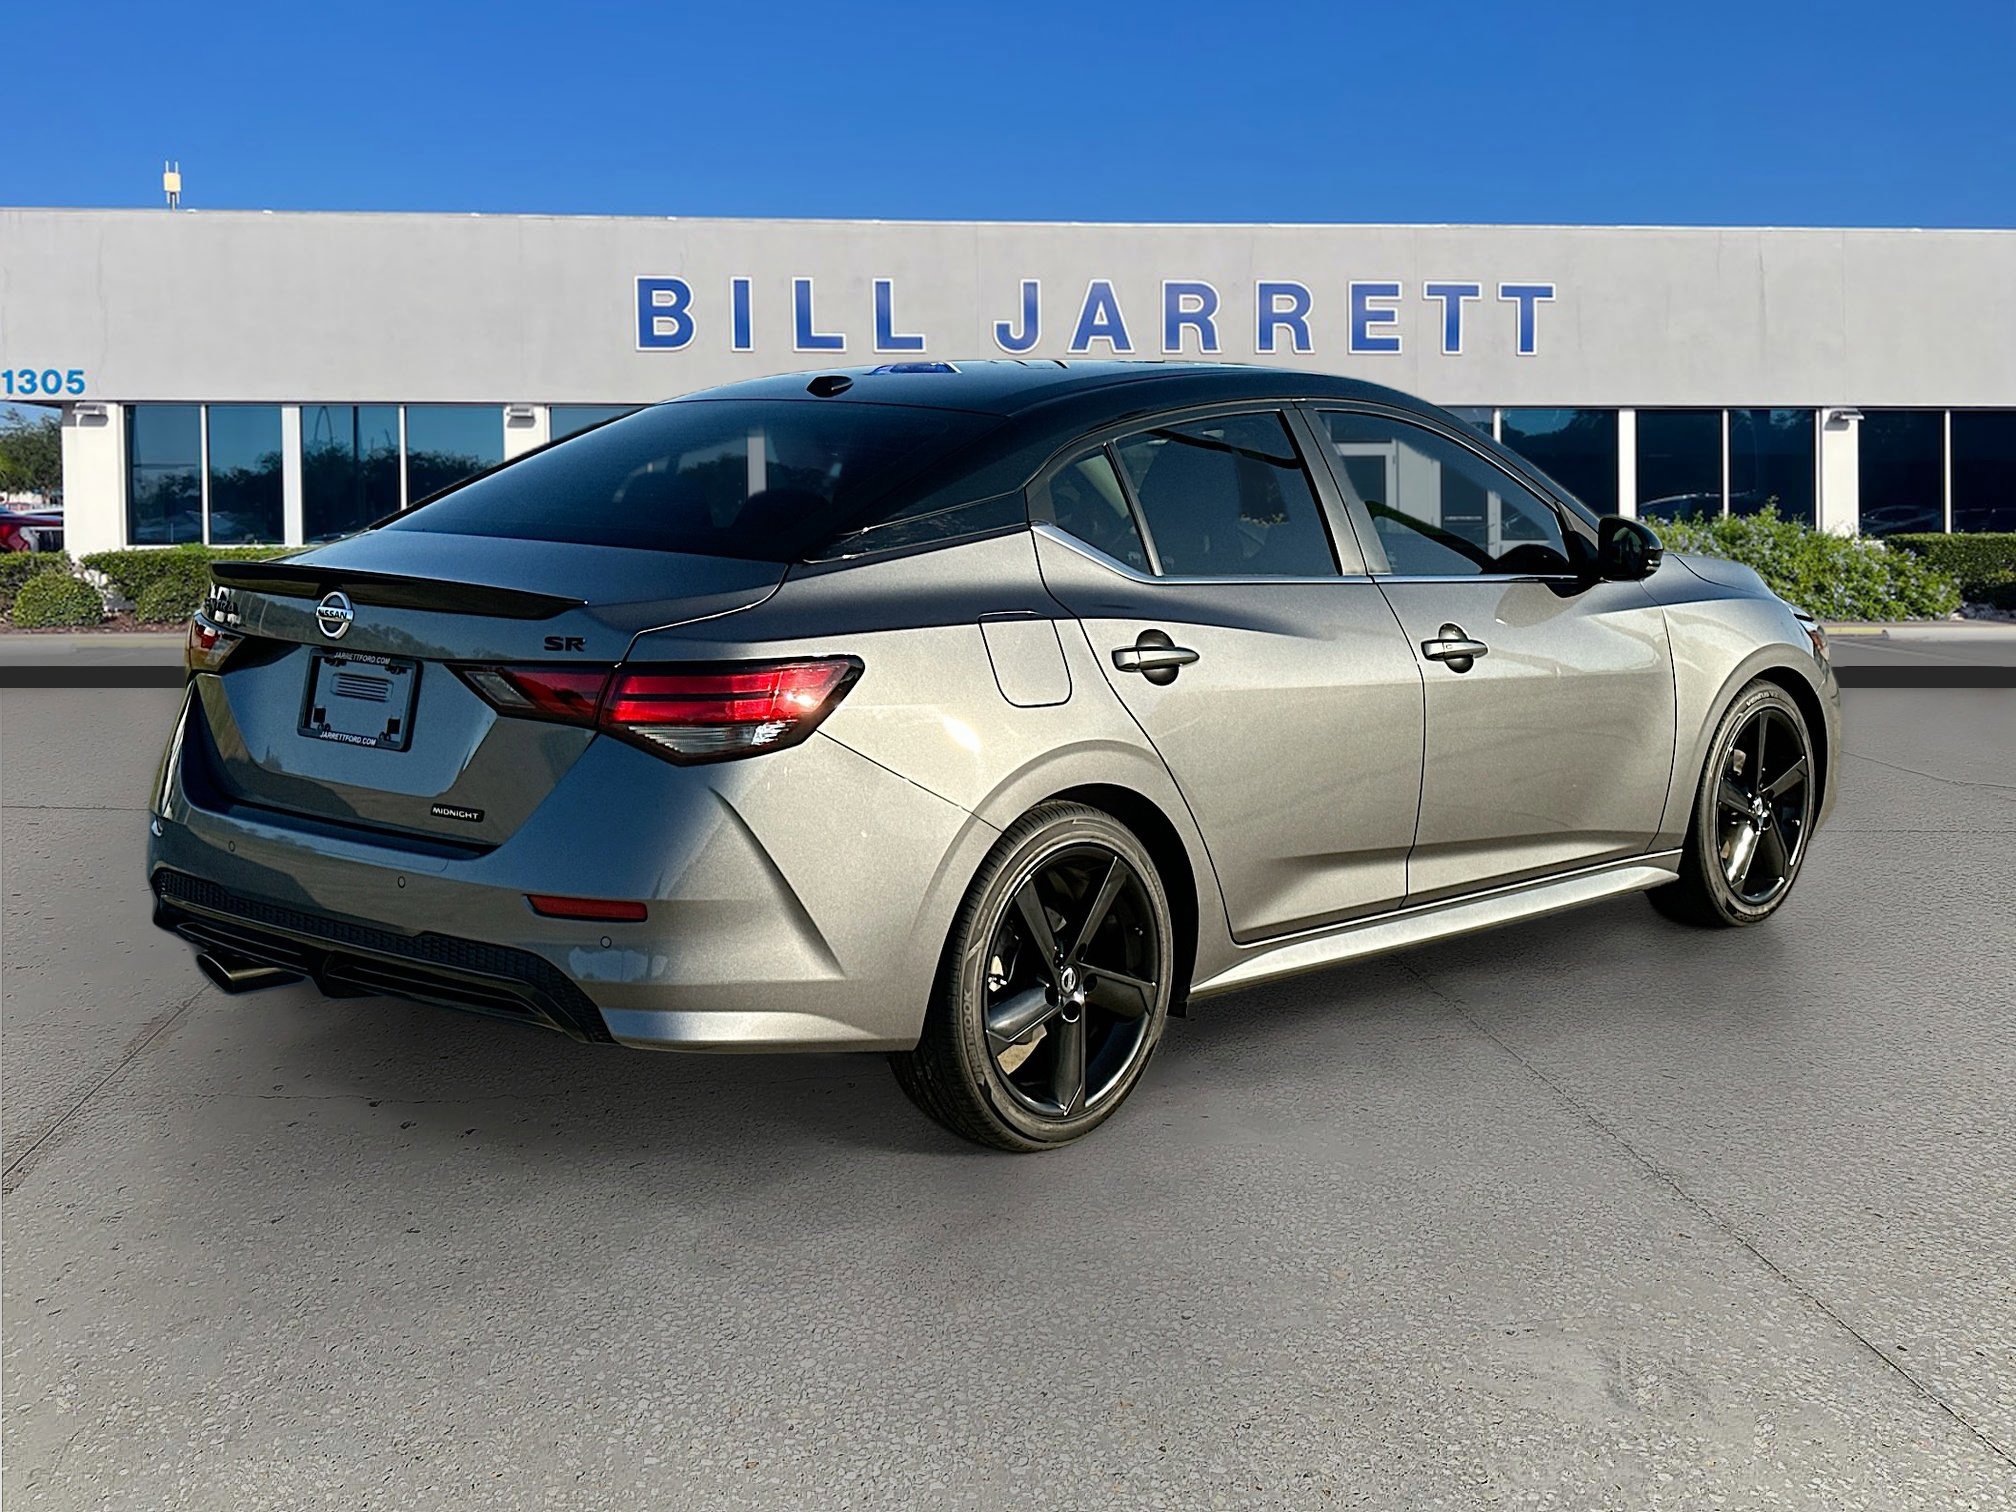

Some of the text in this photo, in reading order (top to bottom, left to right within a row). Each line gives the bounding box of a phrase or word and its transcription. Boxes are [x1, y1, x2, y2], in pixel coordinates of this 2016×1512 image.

[634, 275, 1557, 356] BILL JARRETT
[1, 368, 86, 395] 1305
[543, 635, 586, 652] SR
[320, 731, 377, 746] JARRETTFORD.COM
[432, 806, 479, 820] MIDNIGHT
